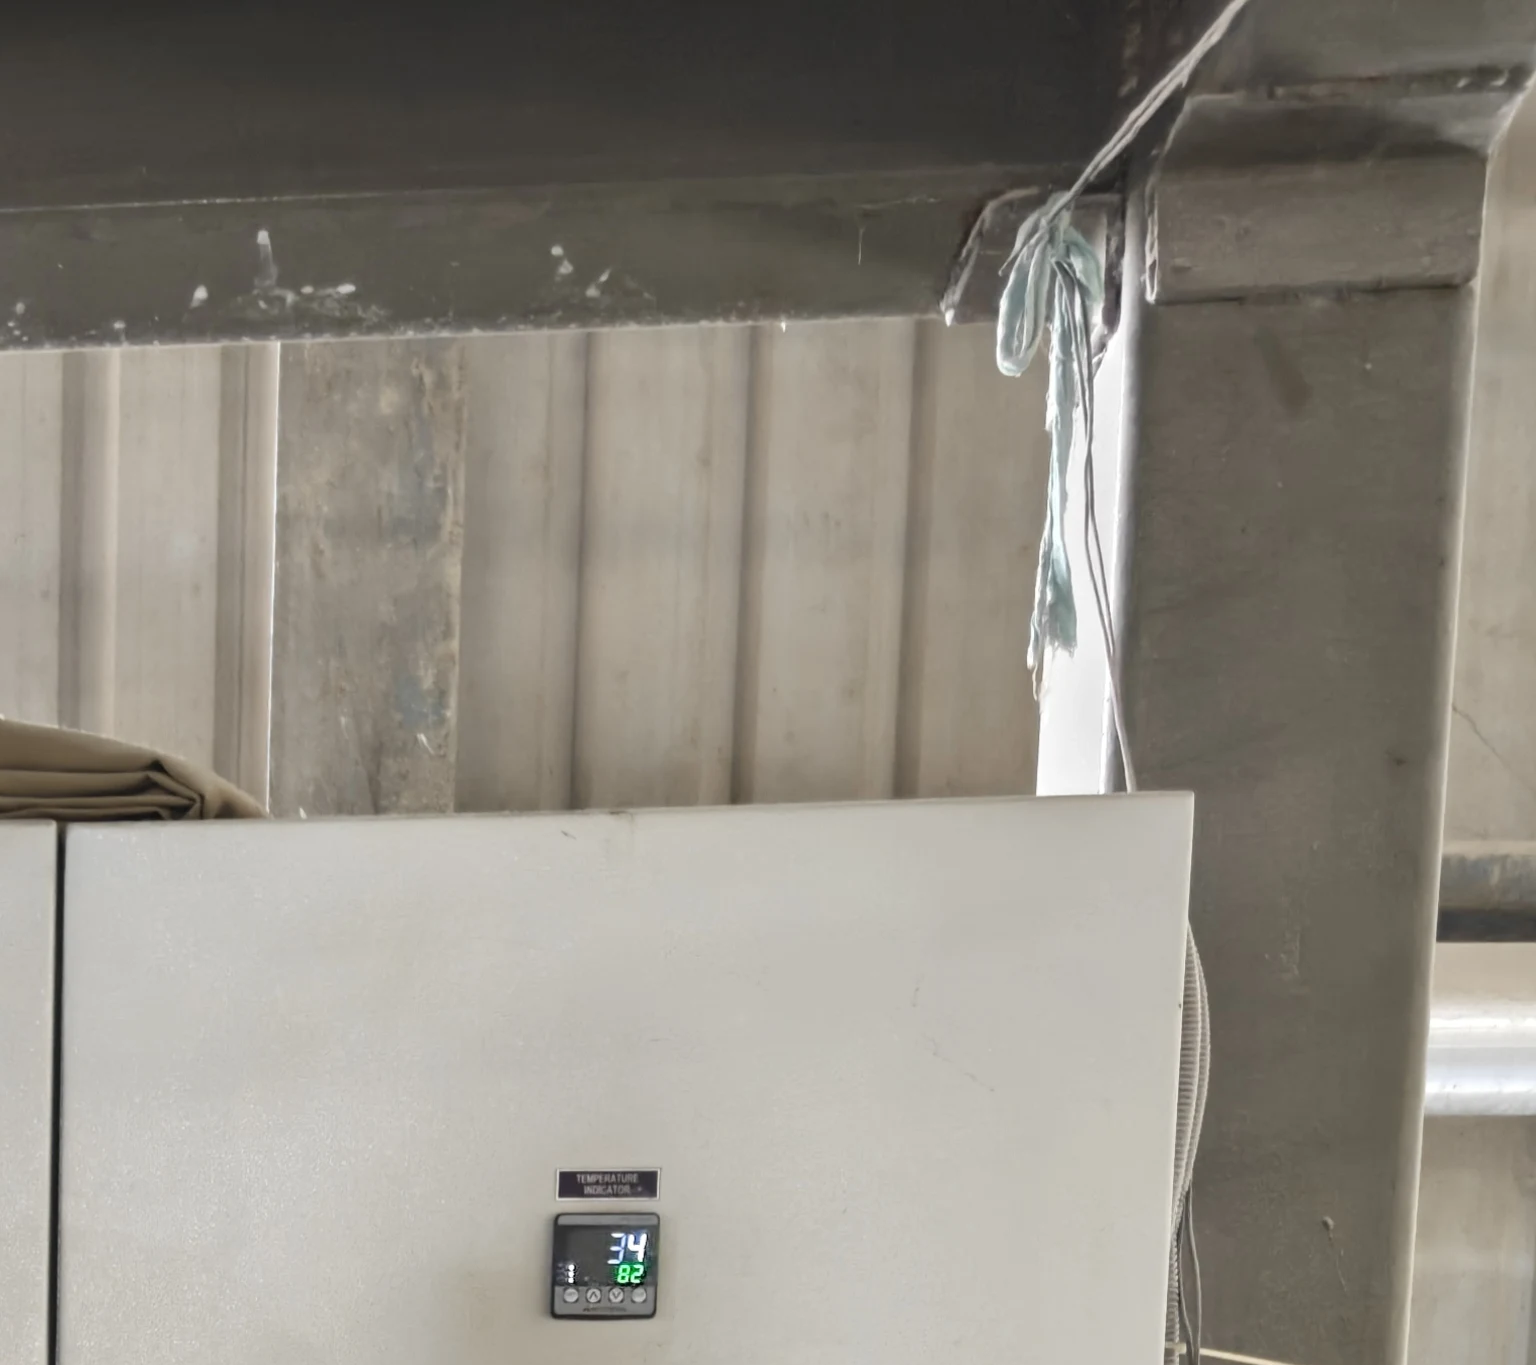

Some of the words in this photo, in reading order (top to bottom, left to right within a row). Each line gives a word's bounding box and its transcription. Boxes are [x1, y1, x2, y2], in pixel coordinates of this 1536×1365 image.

[576, 1173, 638, 1184] TEMPERATURE
[583, 1184, 631, 1195] INDICATOR
[607, 1232, 648, 1265] 34
[617, 1264, 644, 1284] 82
